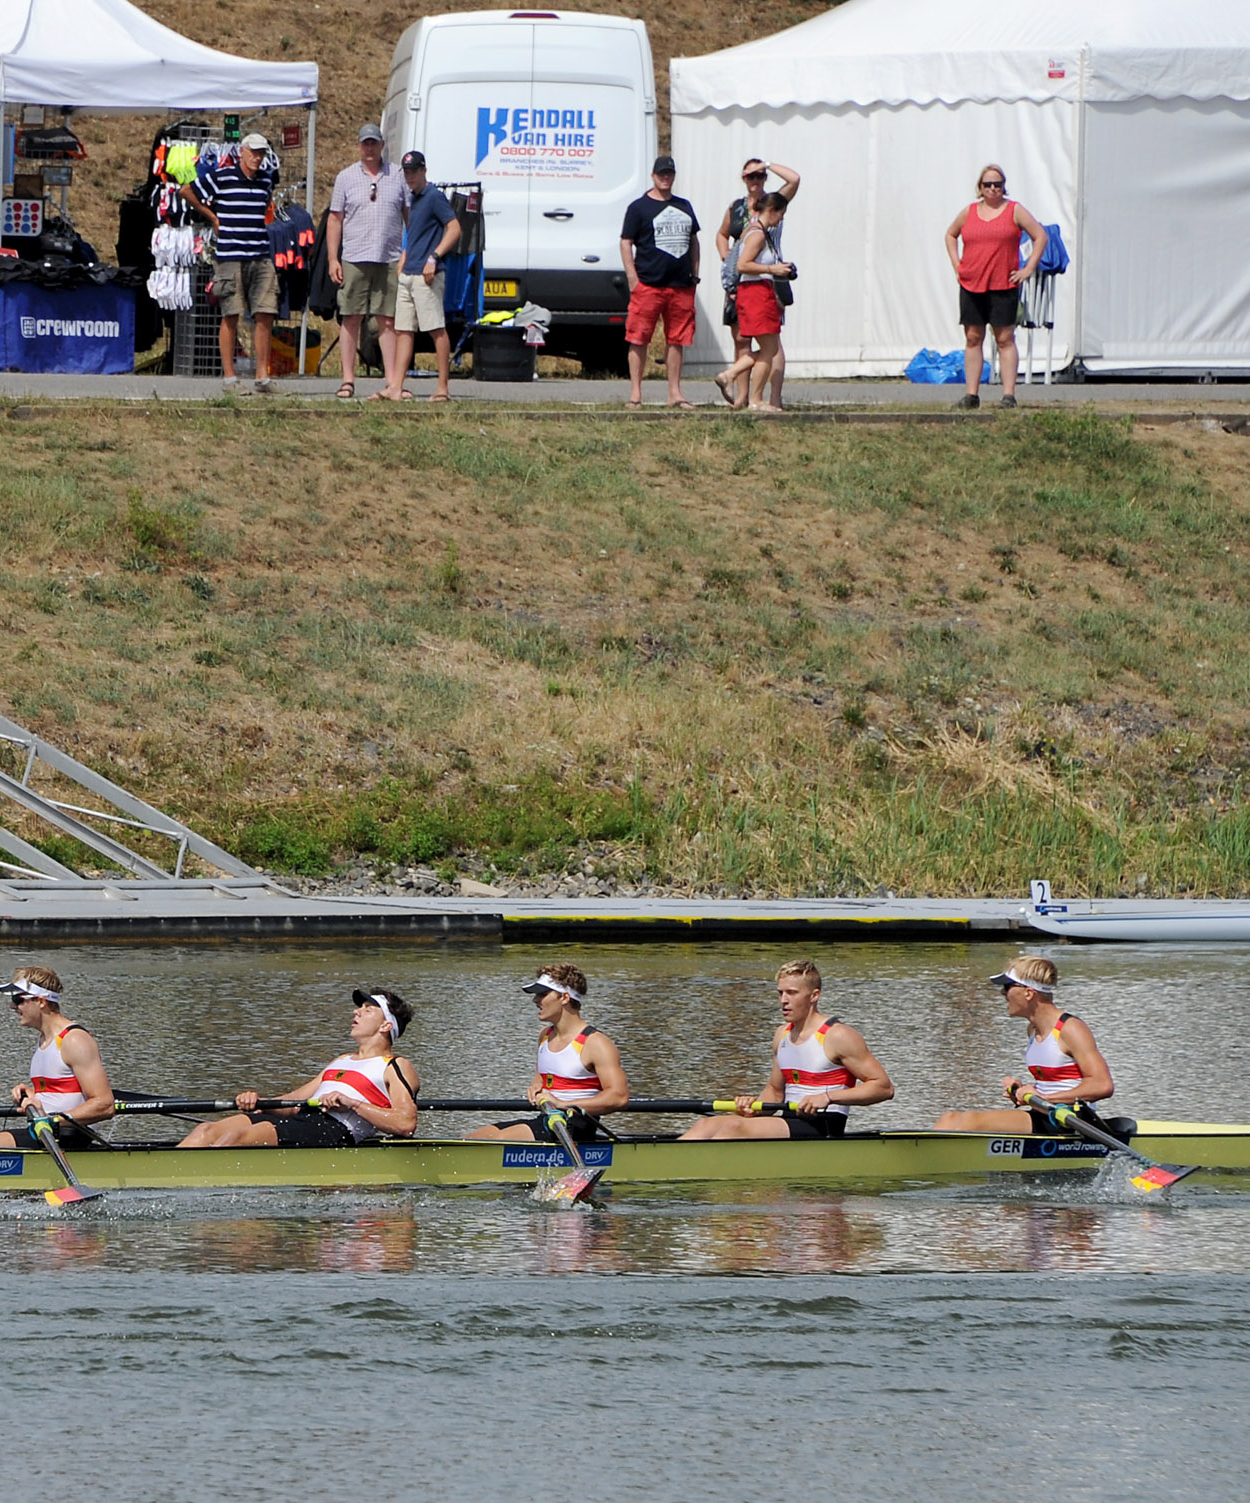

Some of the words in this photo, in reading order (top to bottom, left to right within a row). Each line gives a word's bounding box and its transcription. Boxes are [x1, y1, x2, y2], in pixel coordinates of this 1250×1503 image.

[474, 107, 596, 169] KENDALL
[512, 133, 546, 146] VAN
[554, 133, 594, 147] HIRE
[500, 147, 536, 156] 0800
[539, 148, 565, 157] 770
[568, 149, 595, 157] 007
[485, 282, 508, 294] AUA
[36, 319, 120, 338] crewroom
[1037, 882, 1047, 903] 2
[990, 1140, 1021, 1153] GER
[1081, 1143, 1108, 1153] rowing
[505, 1149, 565, 1164] rudern.de
[585, 1151, 604, 1160] DRV
